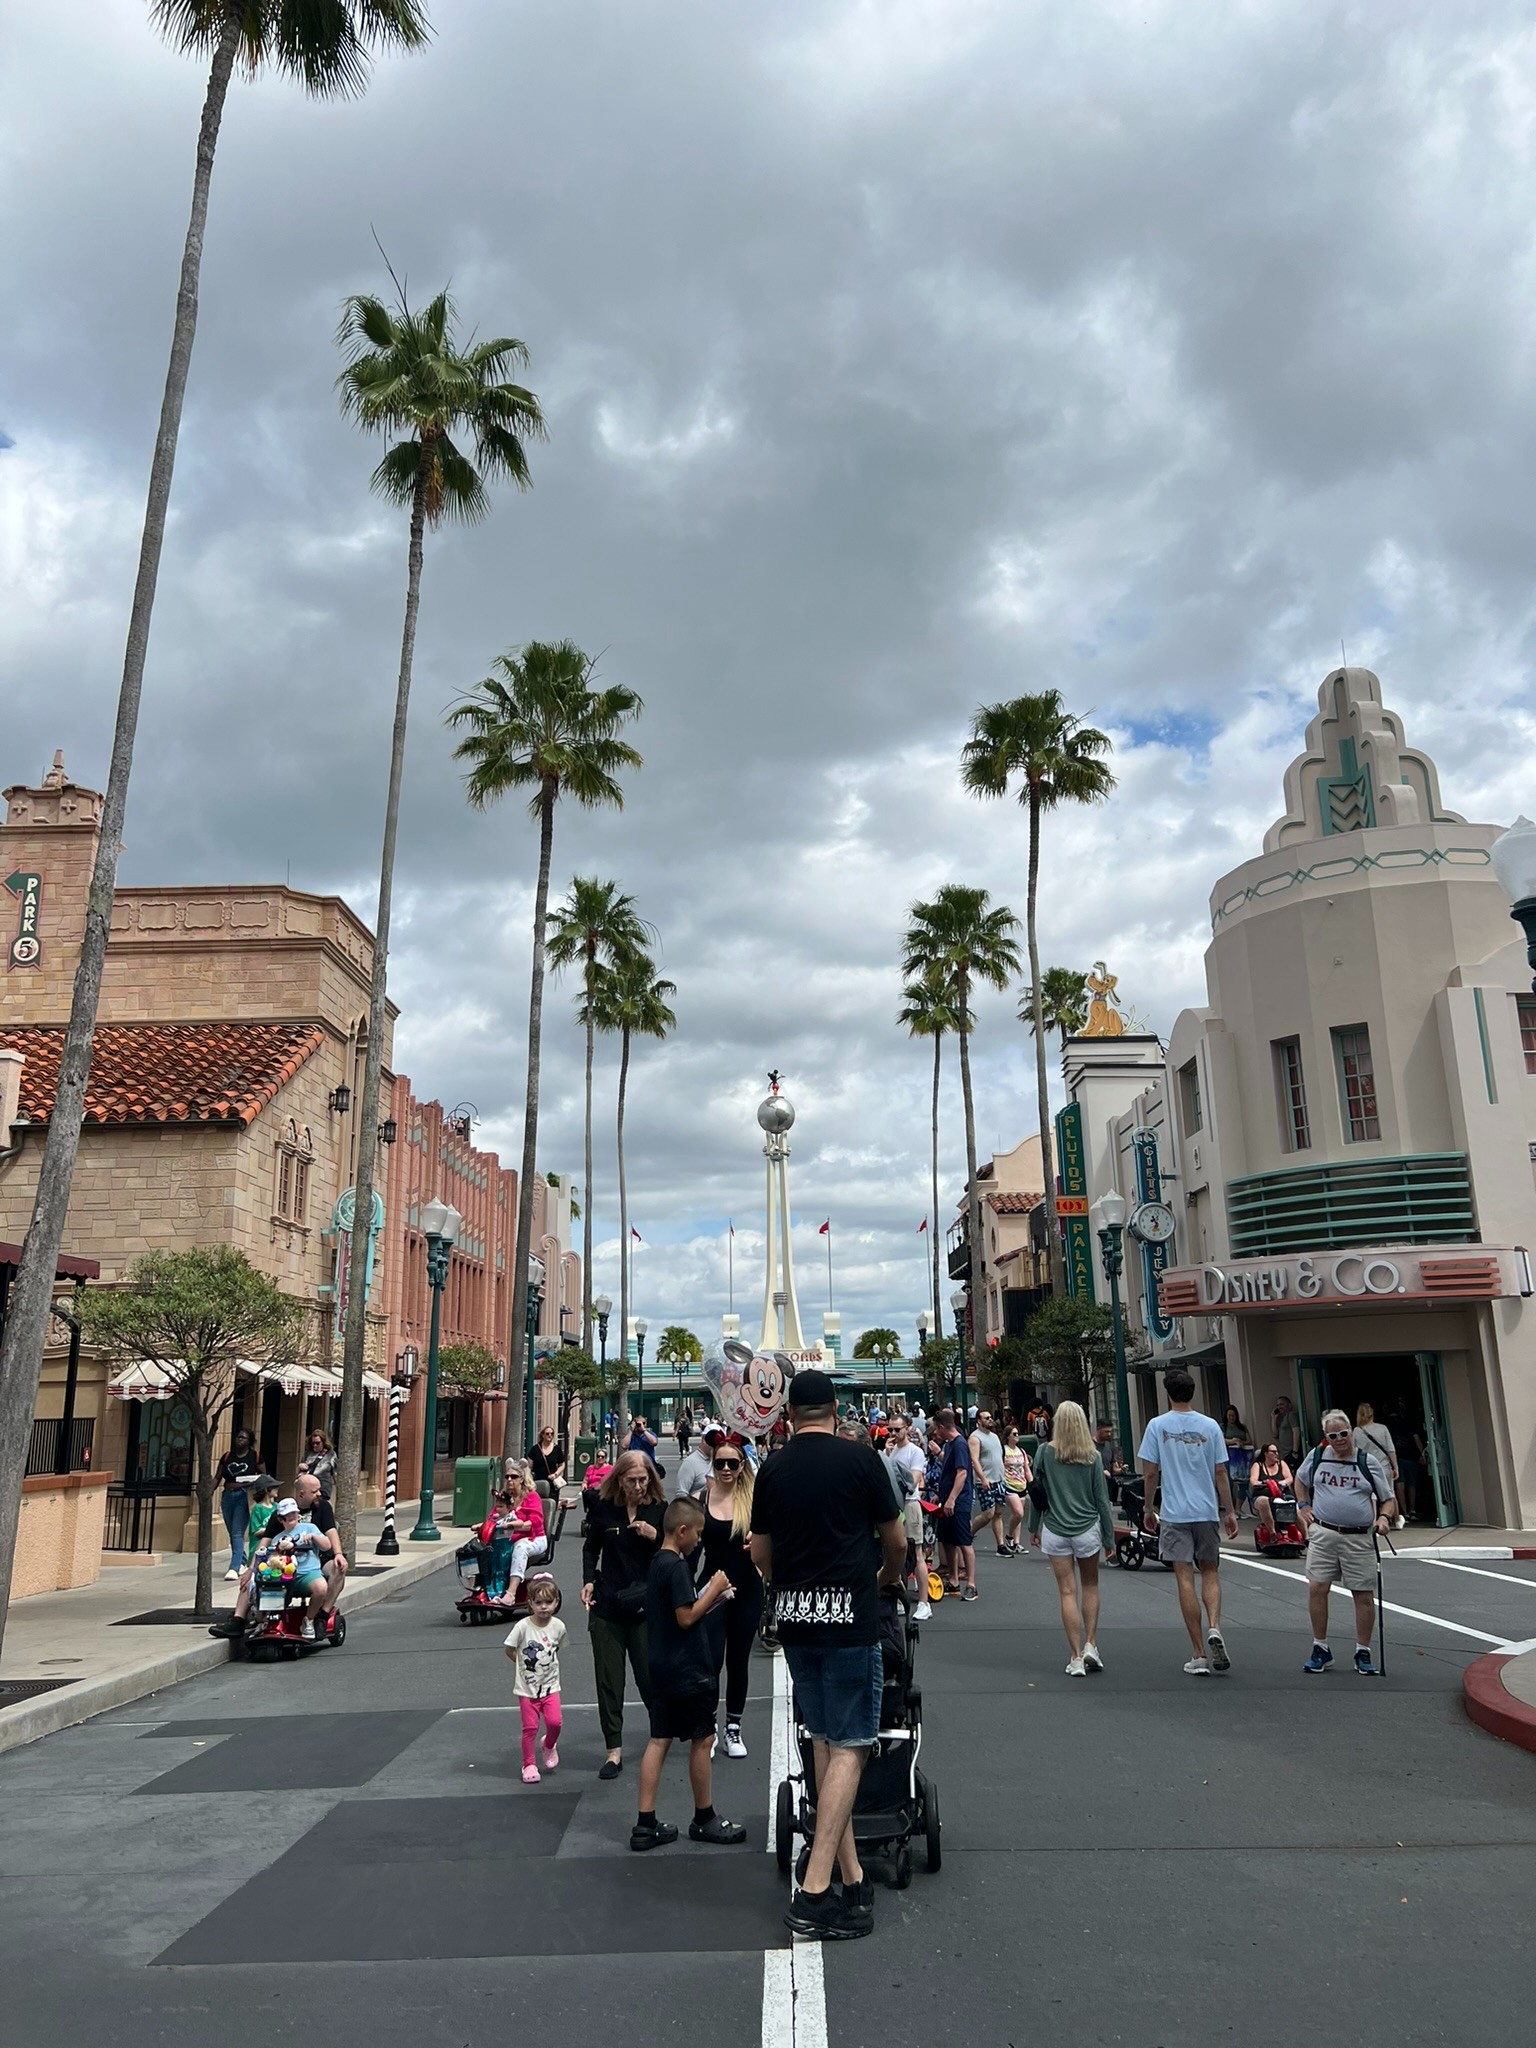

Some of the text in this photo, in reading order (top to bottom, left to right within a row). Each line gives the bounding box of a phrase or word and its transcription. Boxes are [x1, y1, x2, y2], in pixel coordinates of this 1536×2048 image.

[23, 878, 38, 931] PARK
[1143, 1145, 1157, 1200] GIFTS
[1295, 1257, 1322, 1298] &
[1320, 1471, 1360, 1488] TAFT
